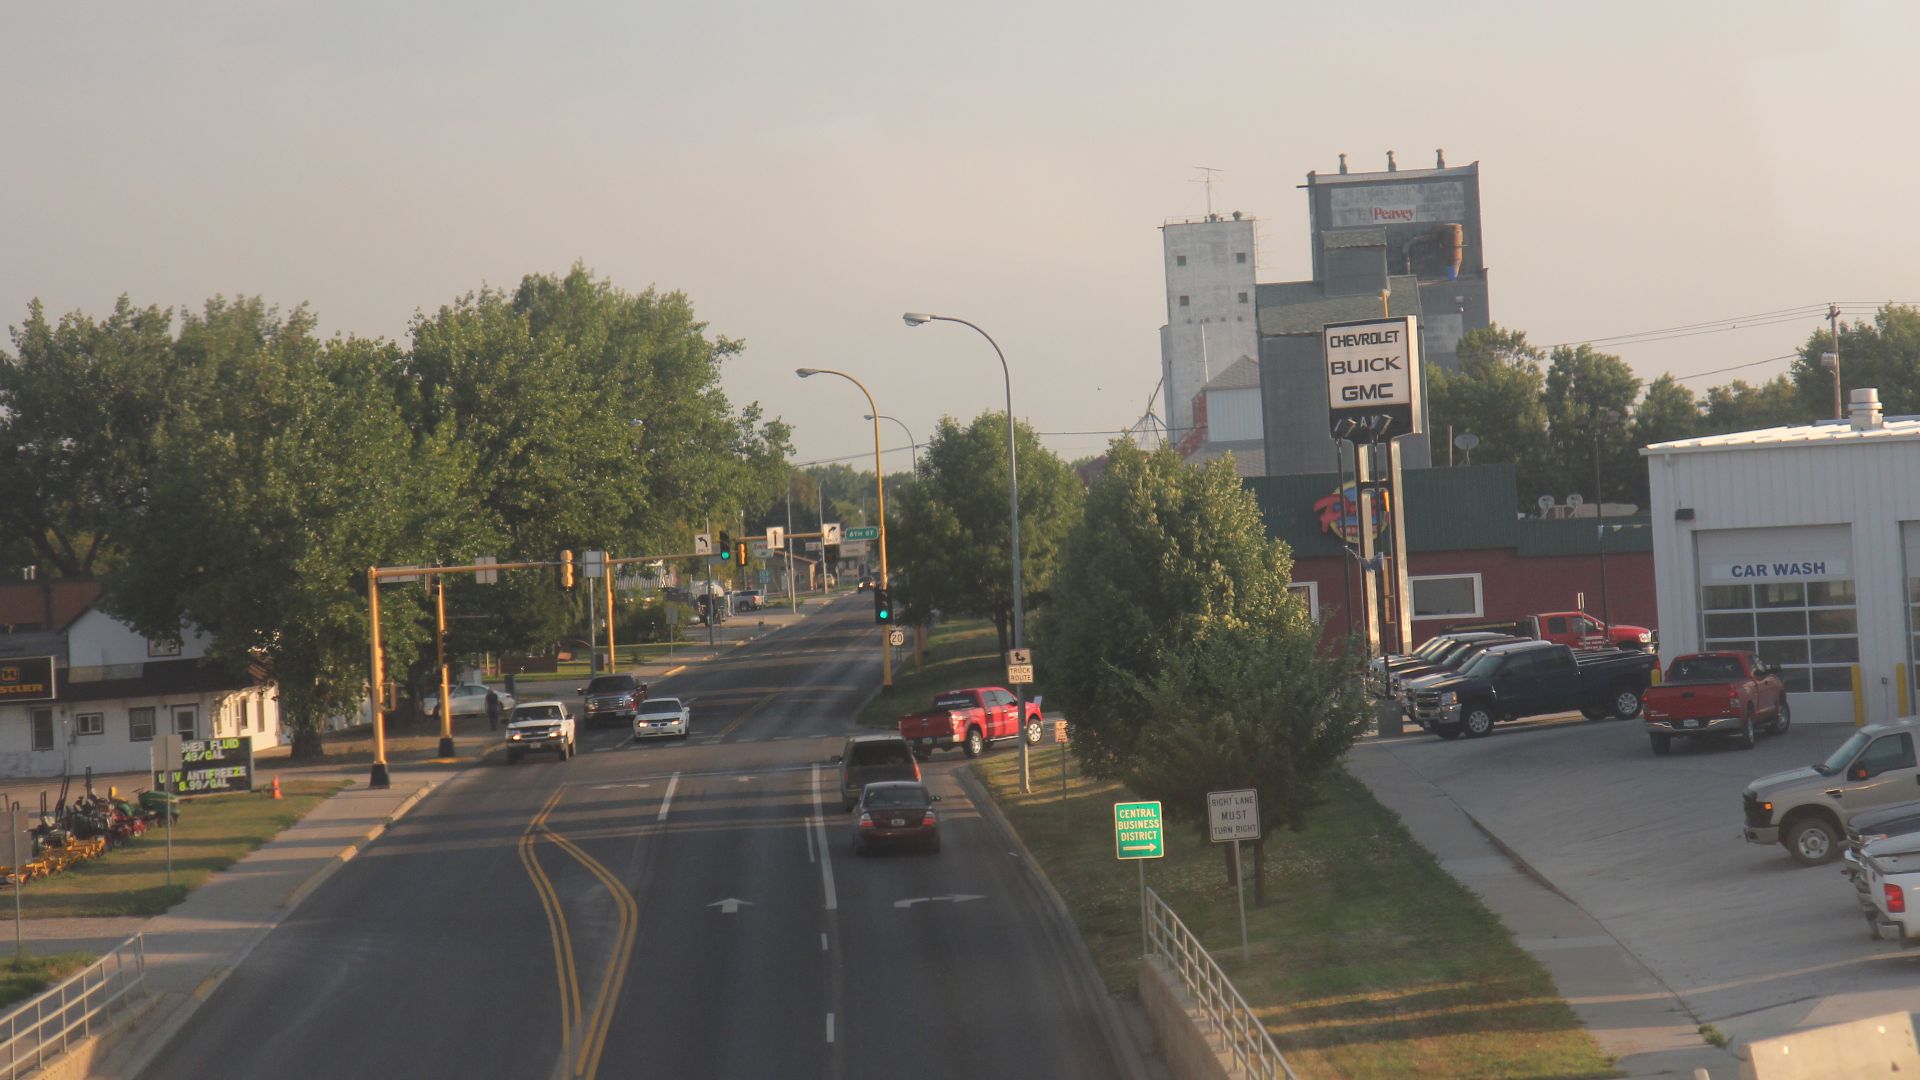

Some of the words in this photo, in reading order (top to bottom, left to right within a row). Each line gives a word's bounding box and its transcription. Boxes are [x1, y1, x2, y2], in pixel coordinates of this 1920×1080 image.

[1374, 207, 1413, 221] Peavey
[1330, 330, 1399, 348] CHEVROLET
[1330, 356, 1401, 375] BUICK
[1342, 383, 1393, 401] GMC
[1731, 564, 1768, 578] CAR
[1772, 562, 1826, 576] WASH
[892, 634, 903, 643] 20
[181, 741, 205, 753] SHER
[210, 739, 239, 751] FLUID
[159, 771, 181, 784] UIV
[187, 766, 247, 781] ANTIFREEZE
[179, 779, 230, 792] 8.99/GAL
[1212, 797, 1232, 806] RIGHT
[1235, 795, 1254, 805] LANE
[1119, 808, 1157, 819] CENTRAL
[1221, 810, 1246, 821] MUST
[1118, 819, 1160, 830] BUSINESS
[1214, 826, 1233, 834] TURN
[1236, 824, 1256, 833] RIGHT
[1121, 831, 1158, 841] DISTRICT
